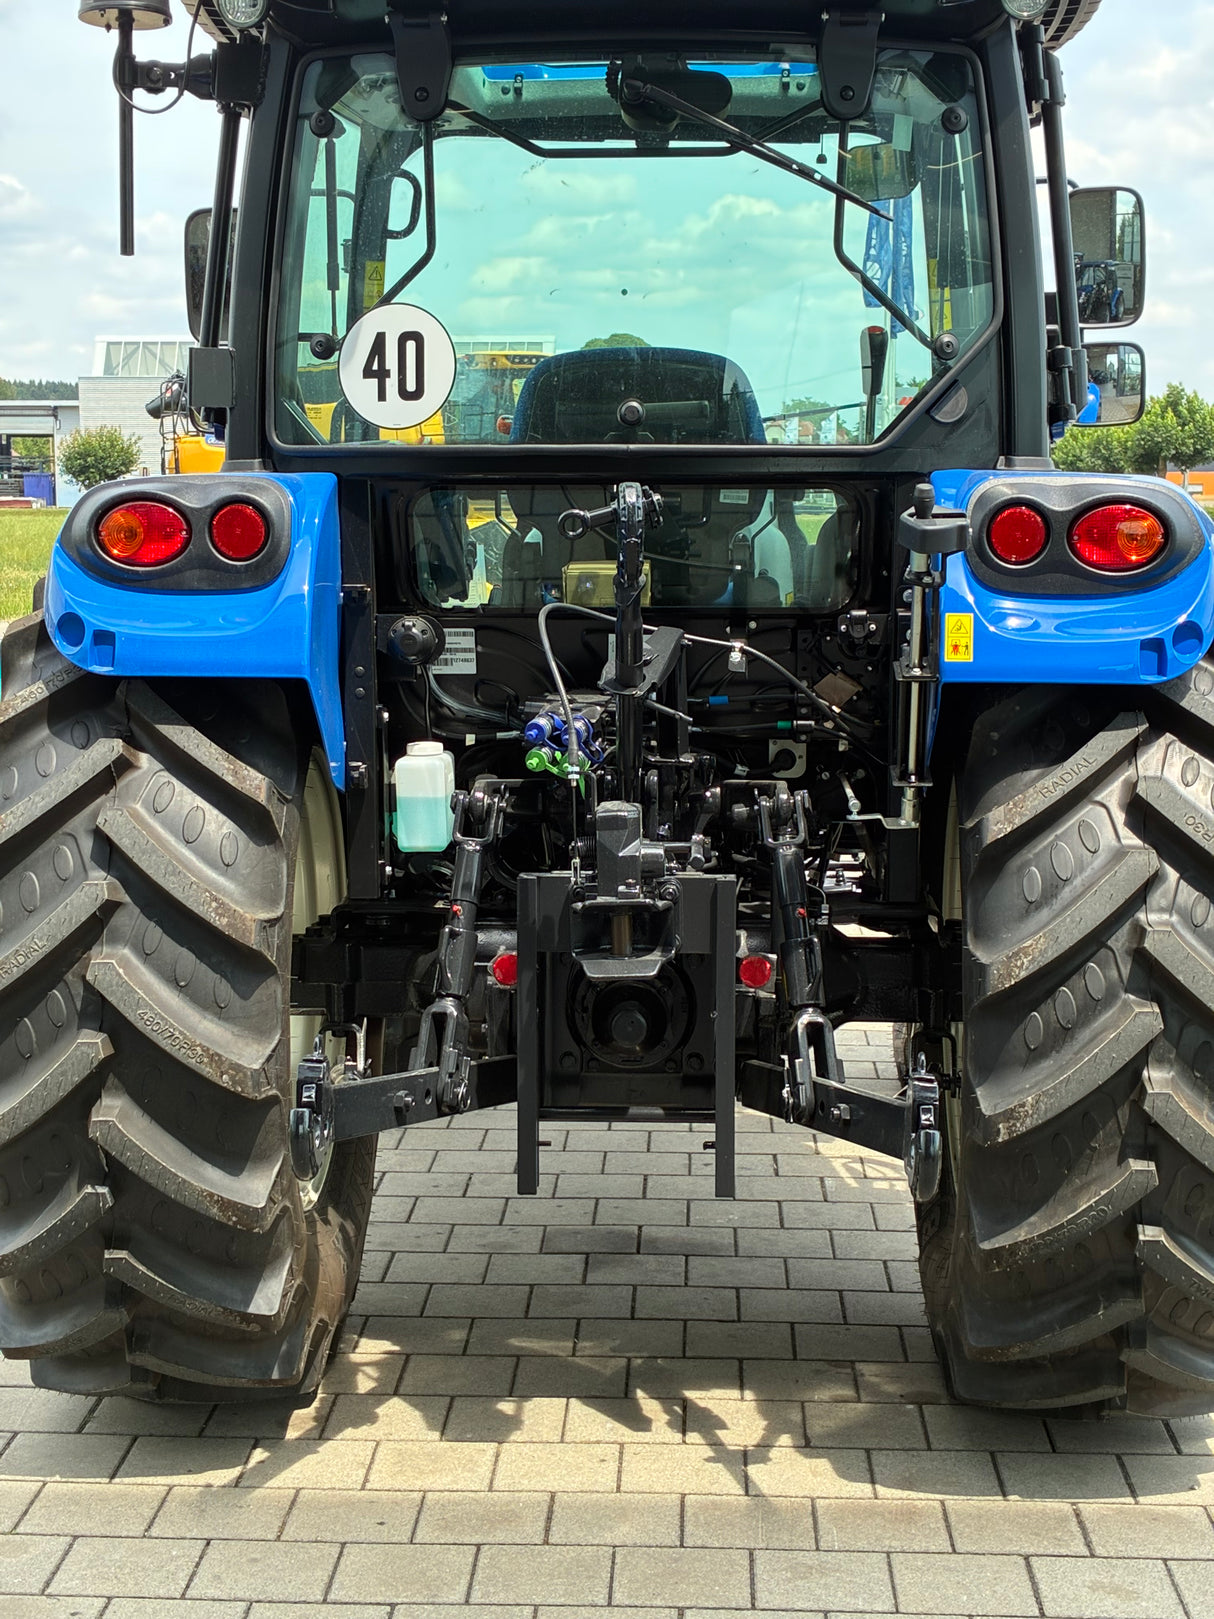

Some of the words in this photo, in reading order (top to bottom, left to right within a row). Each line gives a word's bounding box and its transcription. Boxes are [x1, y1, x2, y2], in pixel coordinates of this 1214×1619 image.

[363, 331, 425, 402] 40
[1039, 757, 1097, 798] RADIAL
[0, 939, 47, 979] RADIAL
[137, 1009, 206, 1064] 480/70R30
